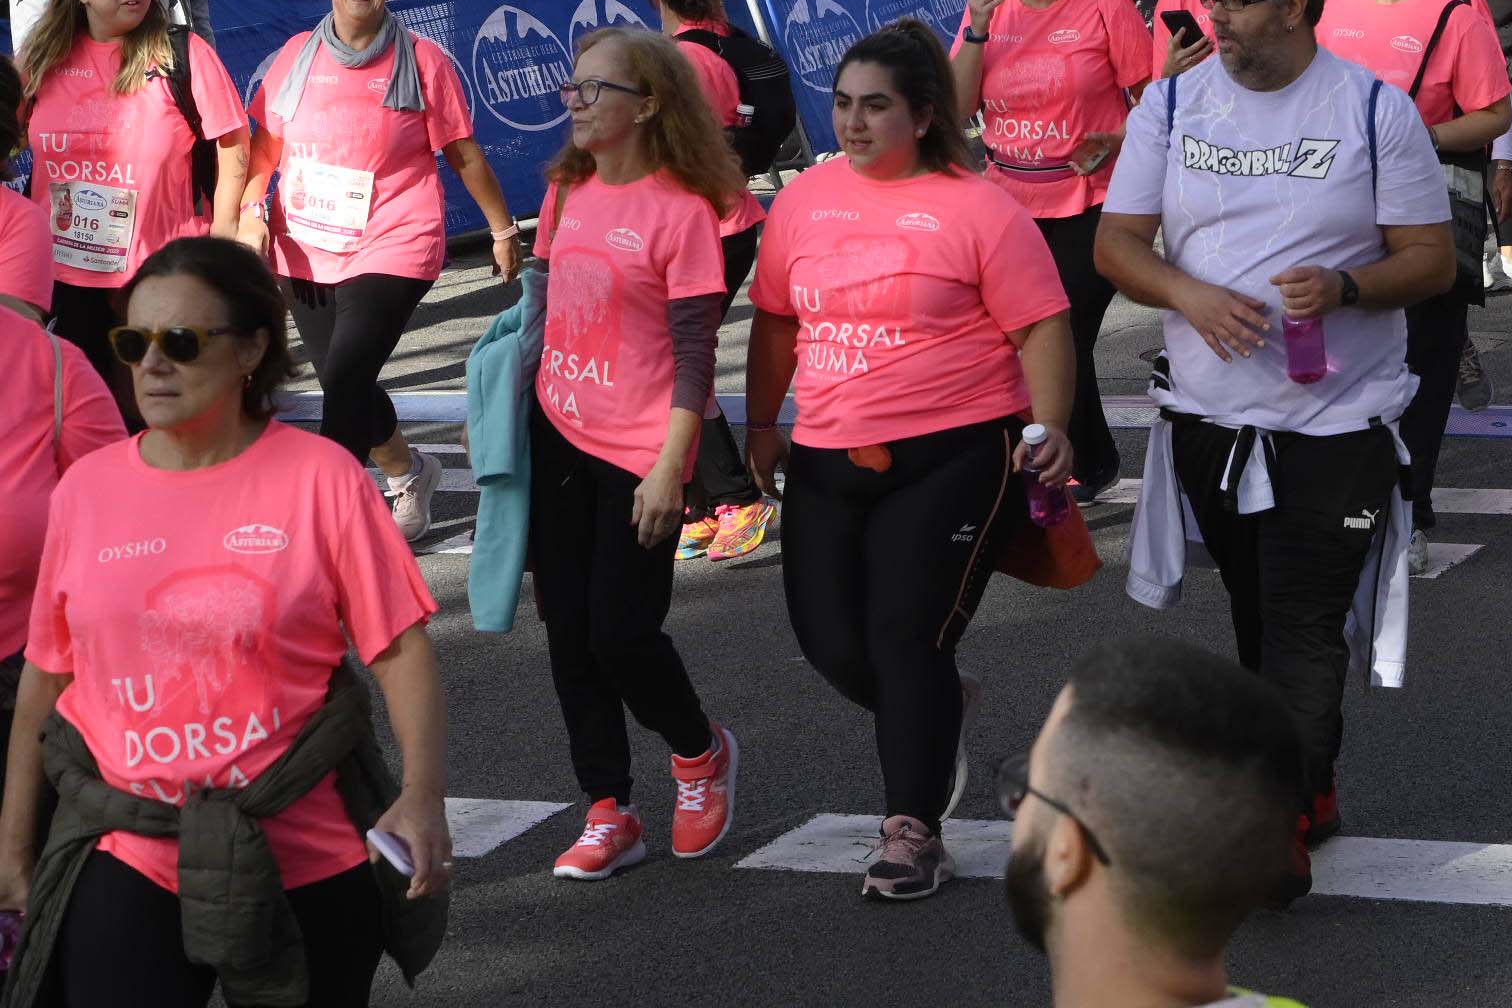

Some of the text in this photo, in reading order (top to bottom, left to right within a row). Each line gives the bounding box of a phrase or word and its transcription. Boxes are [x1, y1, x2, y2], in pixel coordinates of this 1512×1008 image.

[482, 58, 570, 105] ASTURIANA
[995, 117, 1070, 140] DORSAL
[39, 133, 68, 153] TU
[1288, 138, 1341, 179] Z
[46, 160, 135, 184] DORSAL
[76, 195, 105, 209] ASTURIANA
[73, 215, 100, 231] 016
[812, 208, 861, 223] OYSHO
[73, 230, 94, 242] 18150
[793, 285, 821, 313] TU
[806, 342, 870, 374] SUMA
[1343, 517, 1373, 530] PUMA
[98, 538, 167, 563] OYSHO
[228, 533, 287, 549] ASTURIANA
